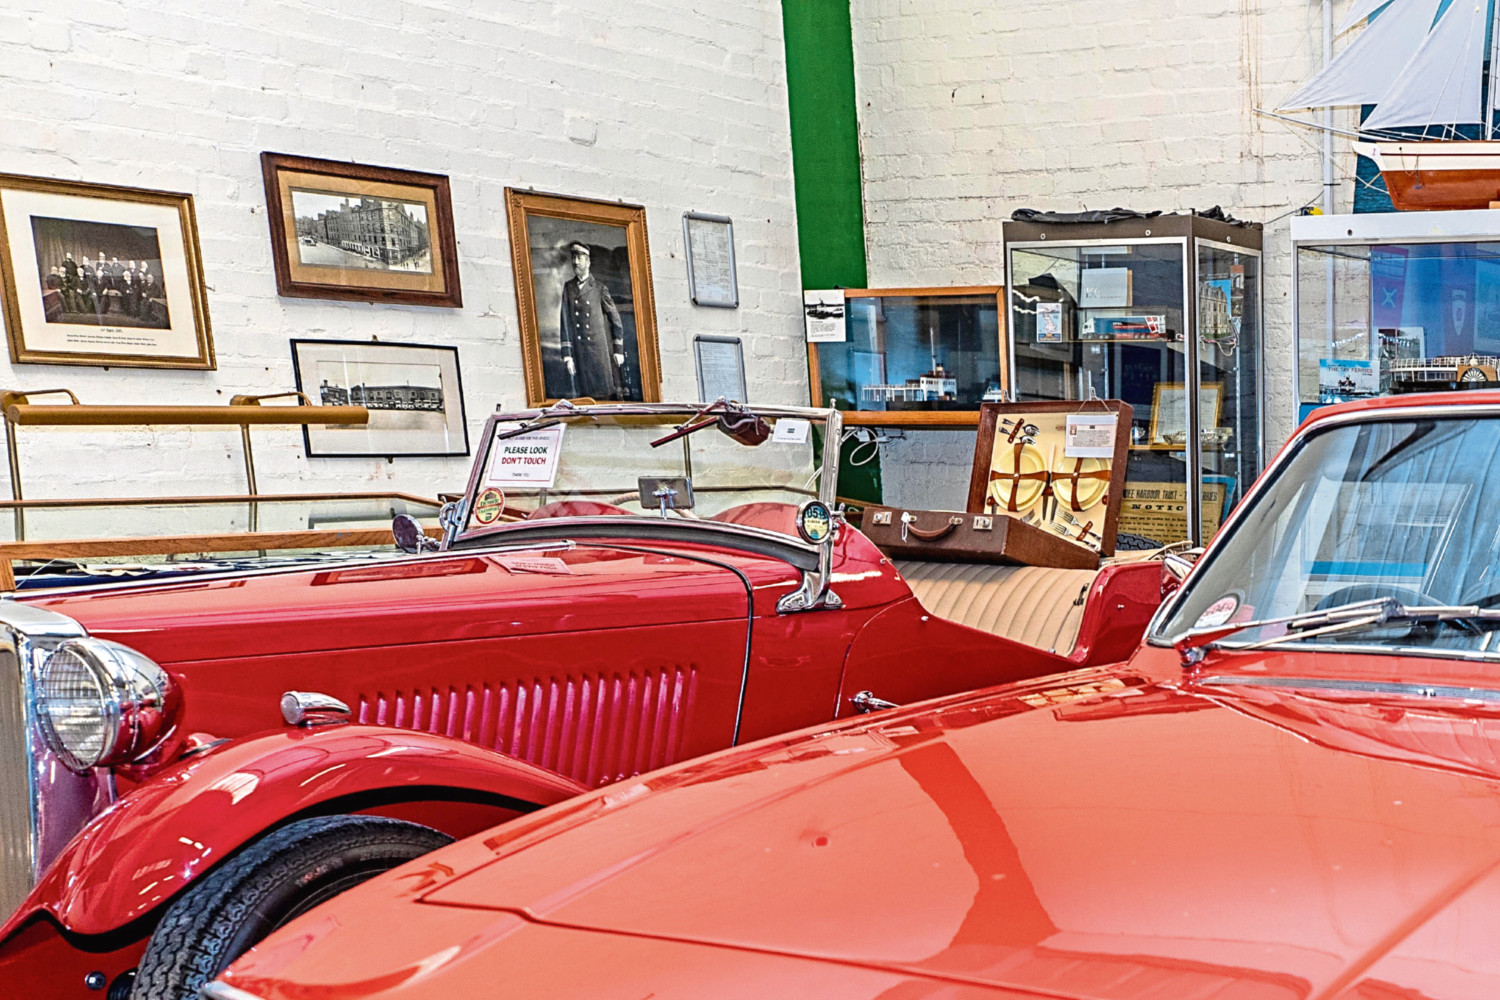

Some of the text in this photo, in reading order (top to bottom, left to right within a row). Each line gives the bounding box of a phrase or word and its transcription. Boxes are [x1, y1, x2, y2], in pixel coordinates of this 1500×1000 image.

[504, 446, 548, 454] PLEASE LOOK
[523, 457, 547, 465] TOUCH
[1136, 489, 1160, 499] HARBOUR
[1162, 490, 1178, 499] TRUST
[1131, 503, 1184, 511] NOTIC
